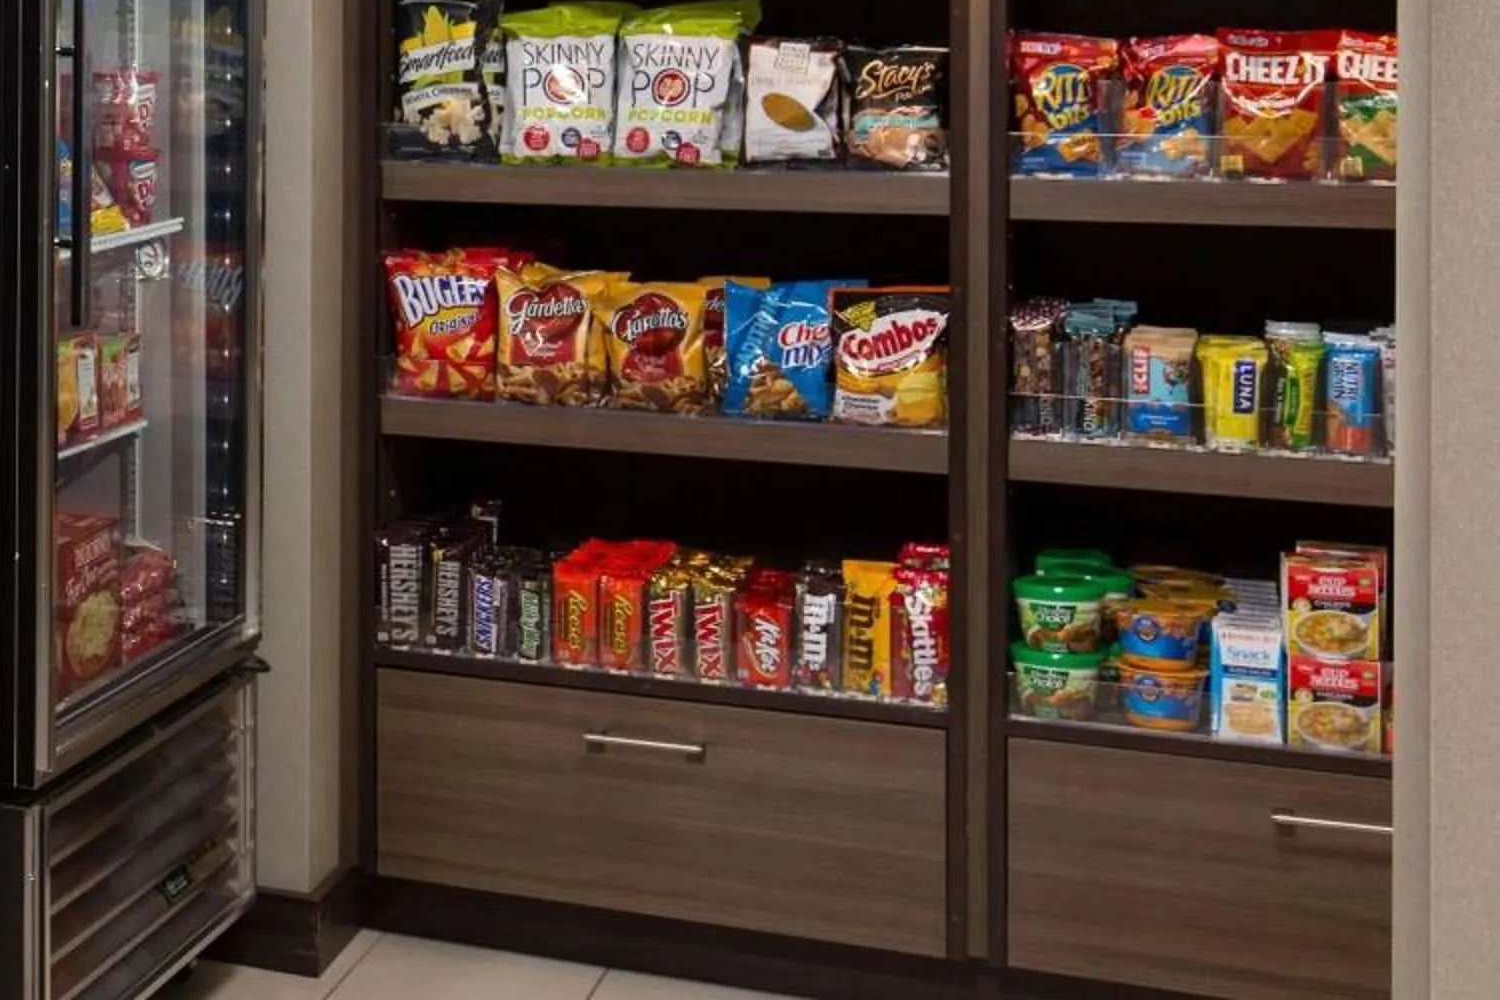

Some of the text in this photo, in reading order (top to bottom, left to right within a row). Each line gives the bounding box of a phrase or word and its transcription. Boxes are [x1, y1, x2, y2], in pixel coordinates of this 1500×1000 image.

[523, 40, 605, 66] SKINNY
[631, 42, 720, 70] SKINNY
[630, 67, 716, 110] POP
[856, 59, 936, 100] Stacy's
[842, 318, 938, 361] Combos
[1239, 364, 1253, 410] LUNA
[650, 592, 679, 674] TWIX
[695, 596, 723, 678] TWIX
[904, 595, 938, 697] Skittles
